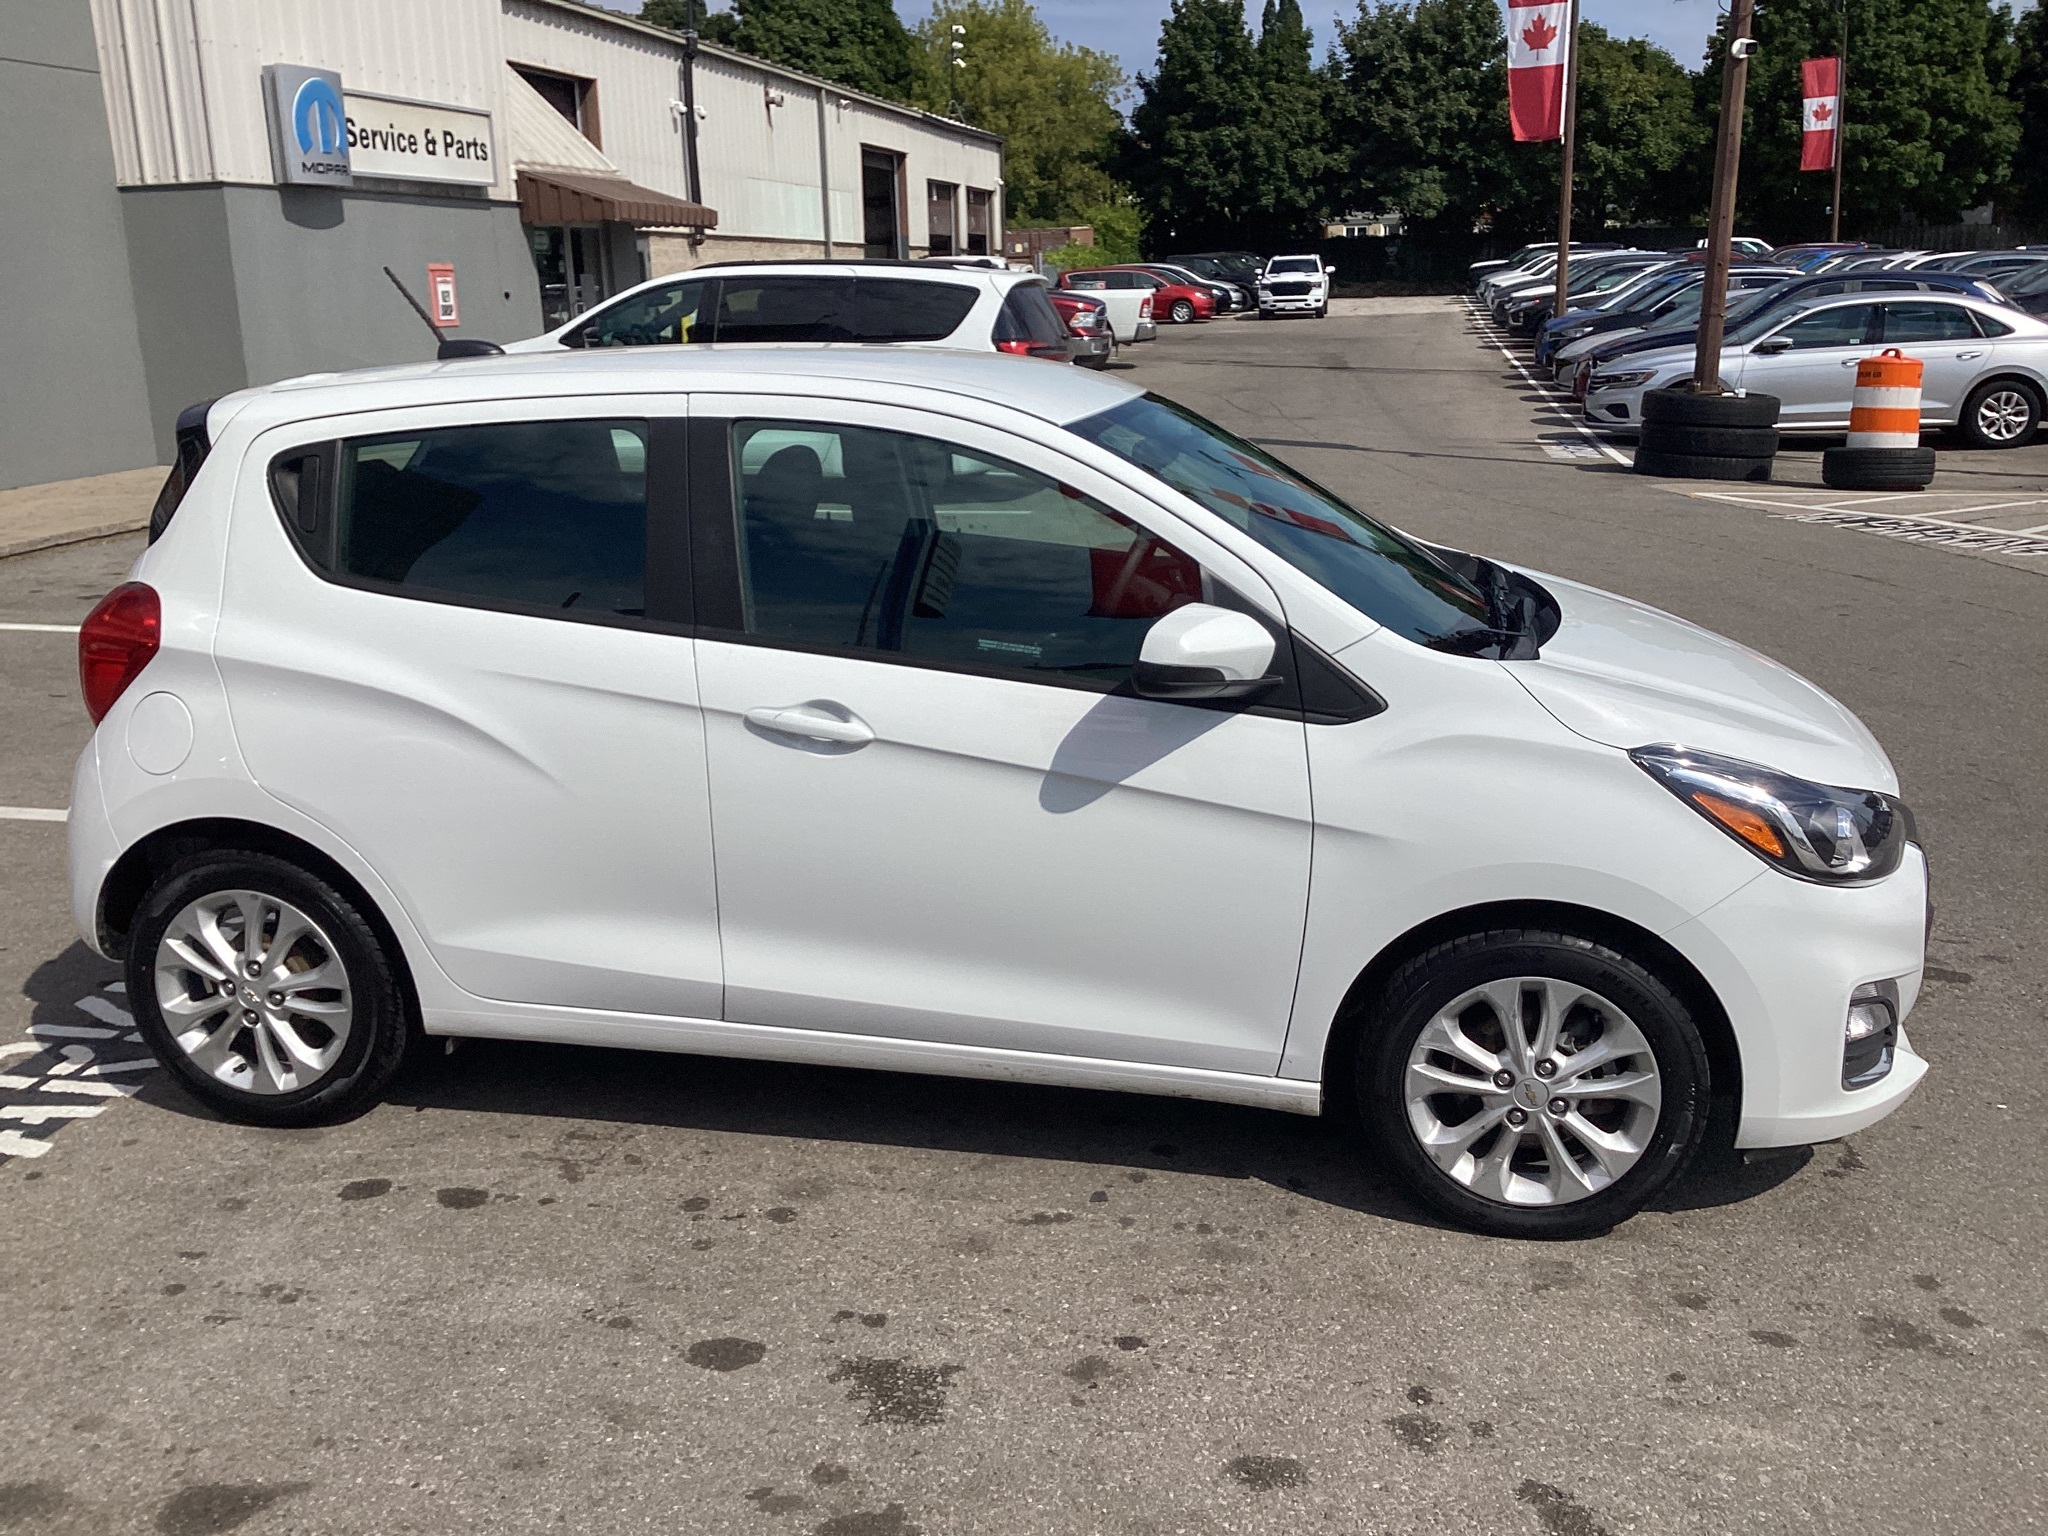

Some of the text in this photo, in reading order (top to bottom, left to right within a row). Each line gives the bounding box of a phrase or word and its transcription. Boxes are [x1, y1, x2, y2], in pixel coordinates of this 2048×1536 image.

[345, 117, 488, 161] Service & Parts
[302, 161, 350, 176] MOPAR
